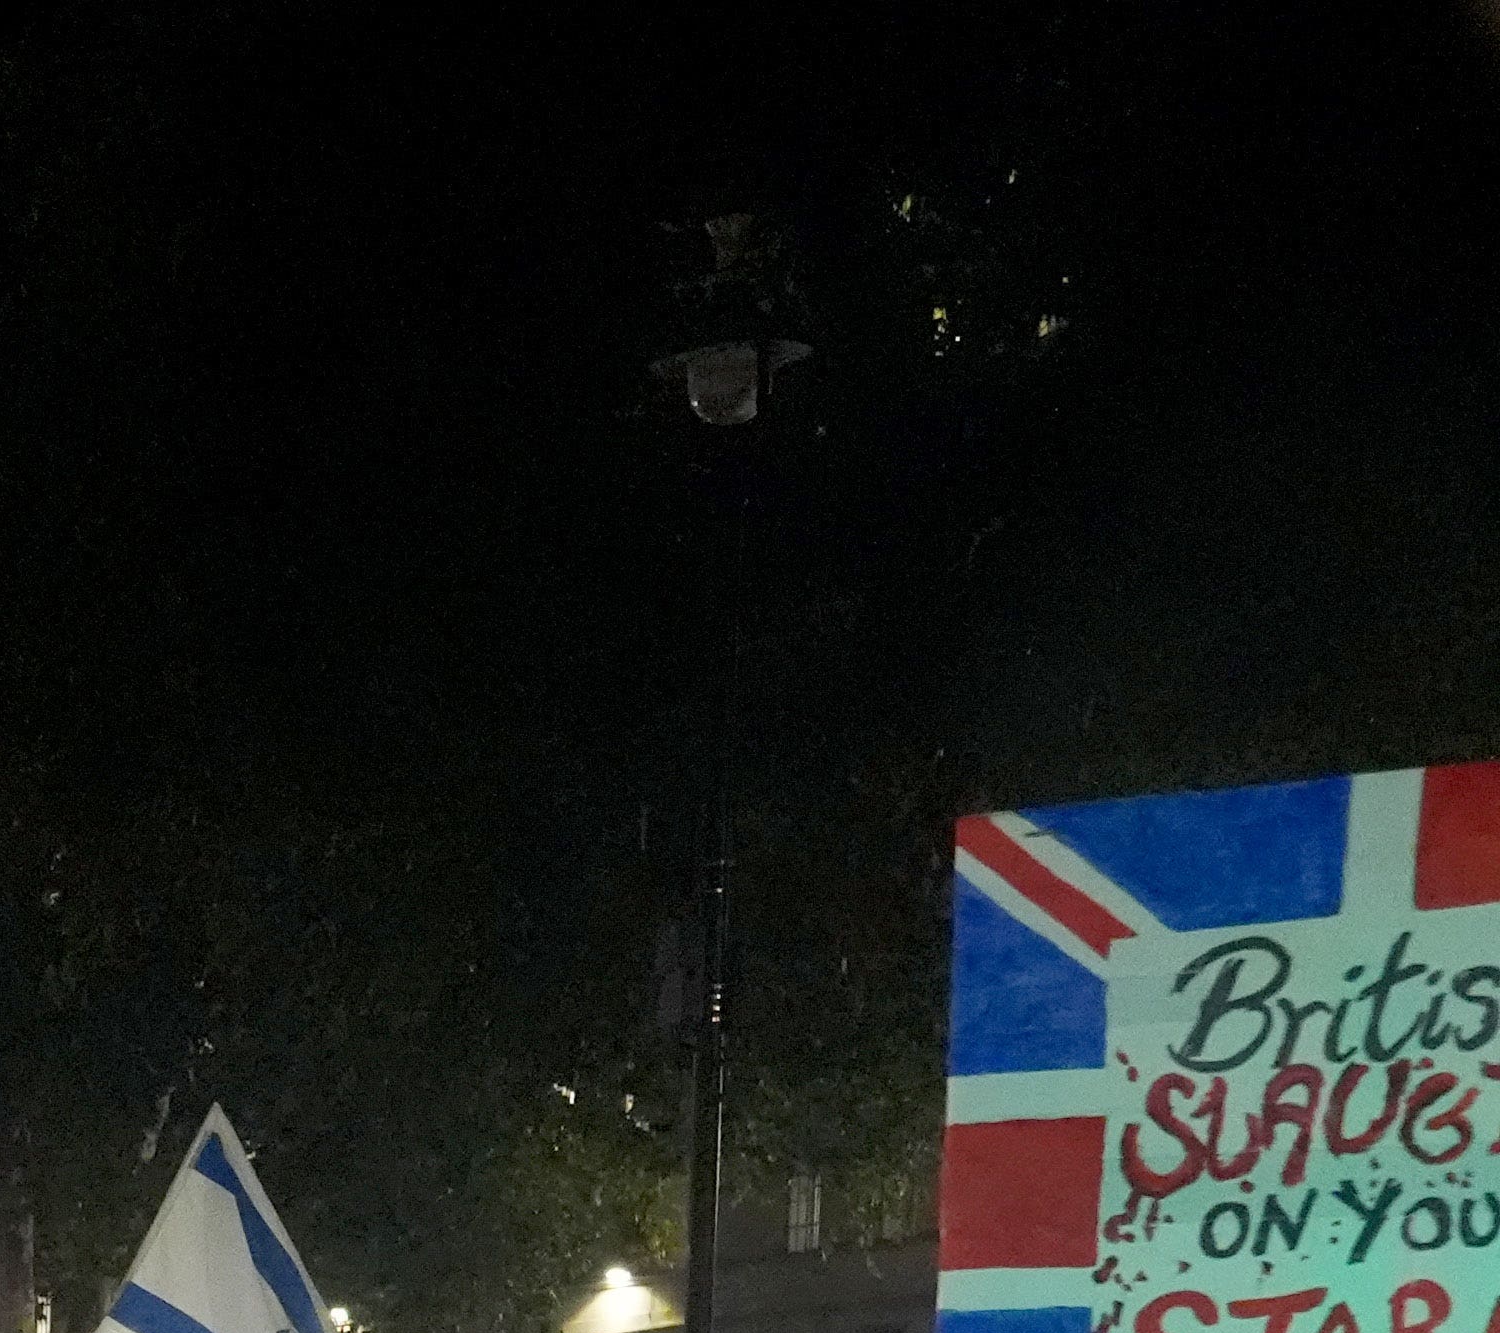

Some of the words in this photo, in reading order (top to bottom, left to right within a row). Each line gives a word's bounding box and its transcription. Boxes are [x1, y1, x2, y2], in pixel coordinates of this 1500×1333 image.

[1168, 931, 1500, 1073] Britis
[1121, 1060, 1500, 1199] SLAUG
[1200, 1188, 1318, 1258] ON
[1331, 1178, 1500, 1265] YOU
